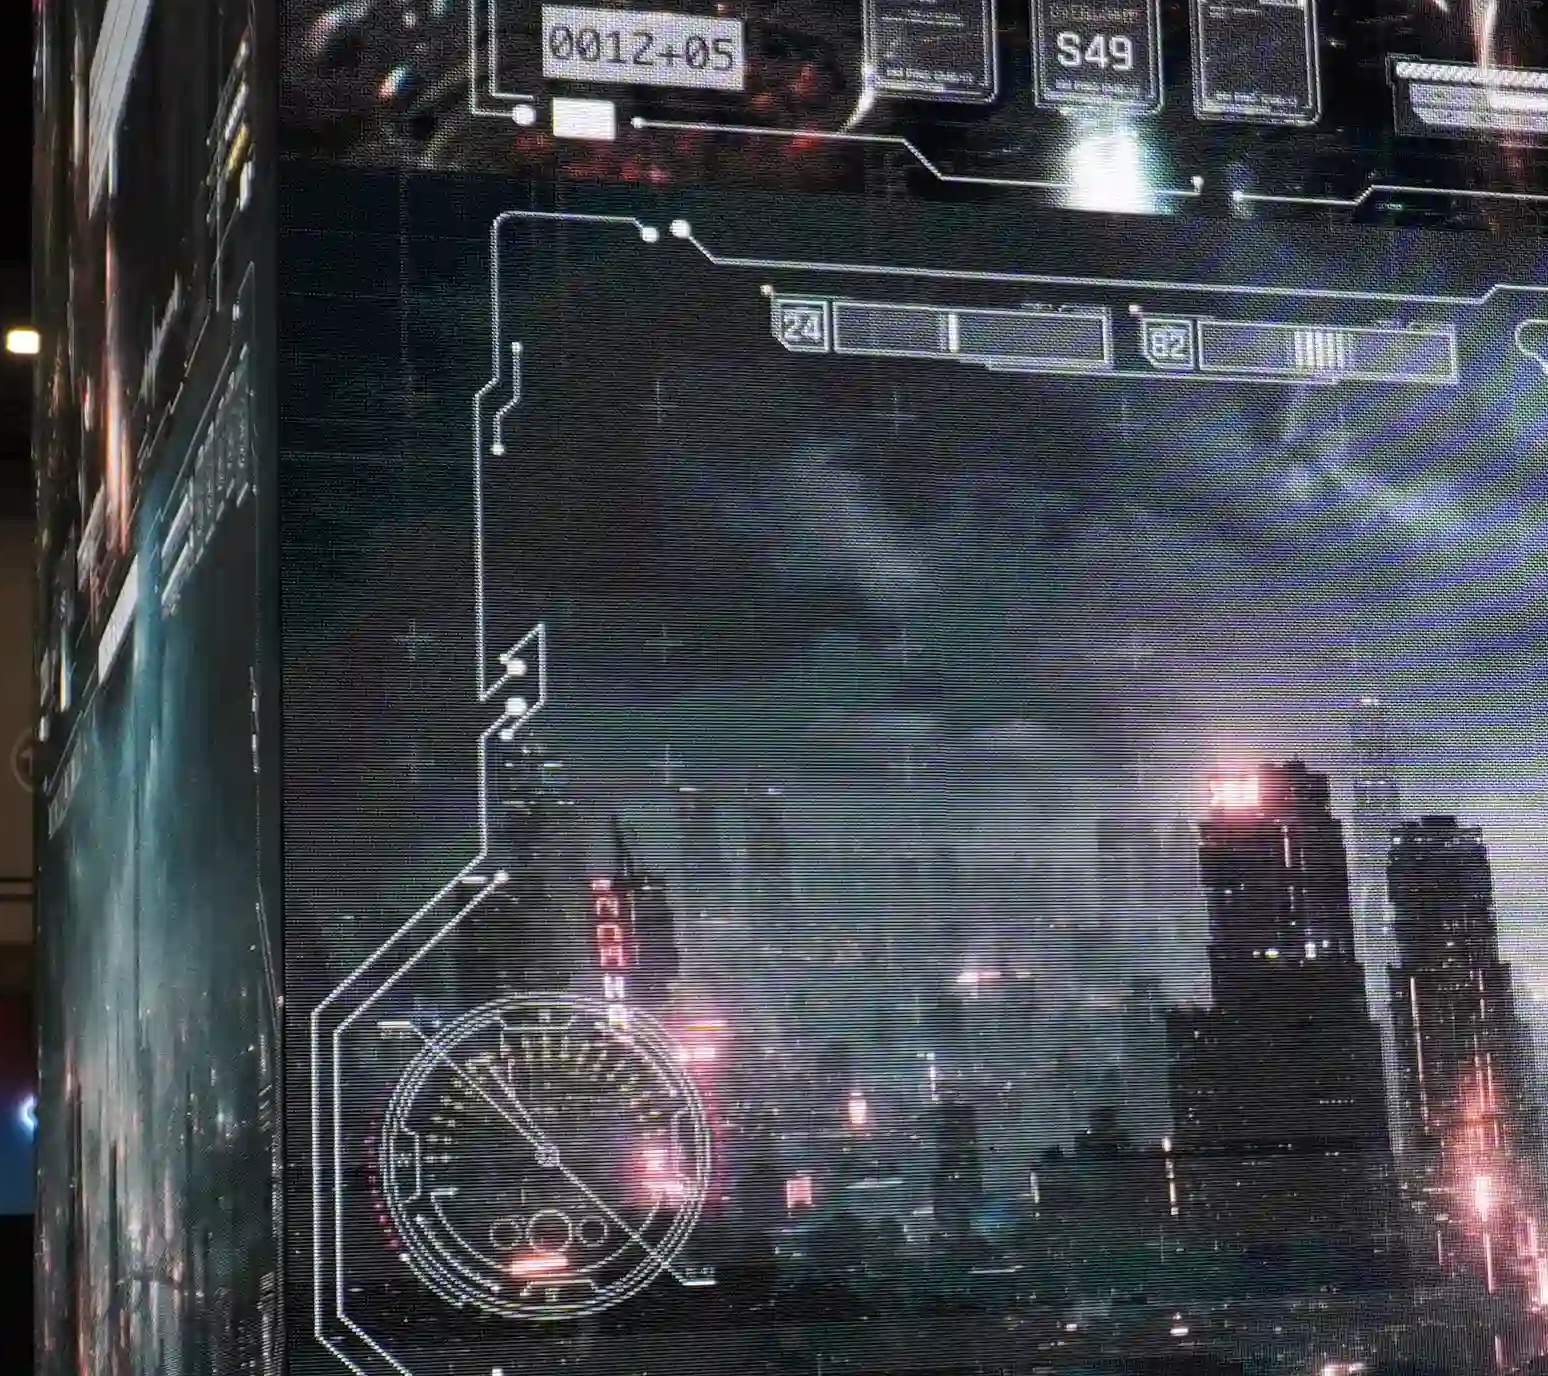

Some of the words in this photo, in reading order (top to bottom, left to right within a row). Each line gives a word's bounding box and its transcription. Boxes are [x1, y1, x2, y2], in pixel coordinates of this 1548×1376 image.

[549, 24, 736, 72] 0012+05
[1056, 30, 1134, 72] S49
[783, 307, 822, 342] 24
